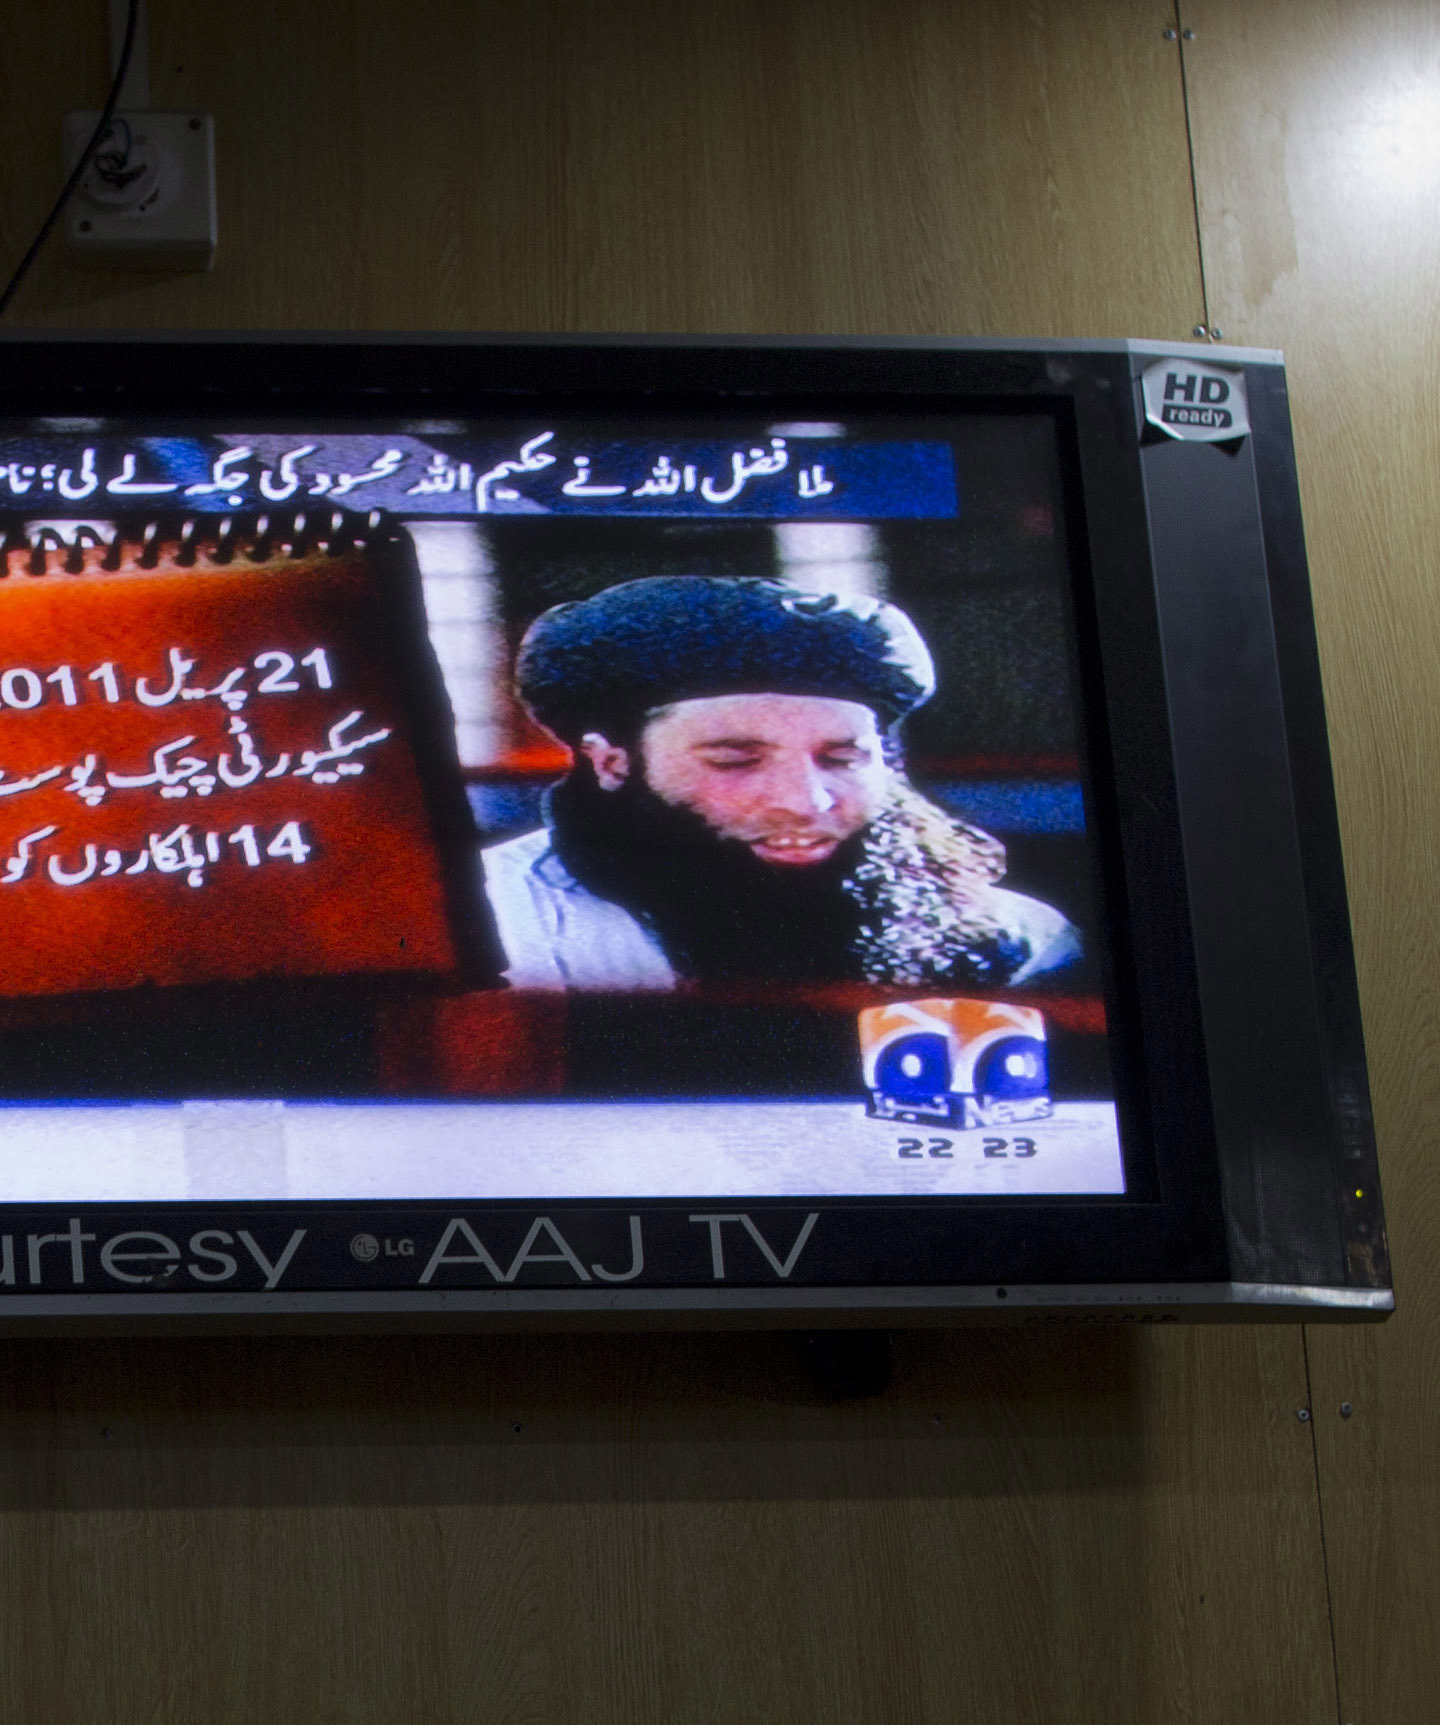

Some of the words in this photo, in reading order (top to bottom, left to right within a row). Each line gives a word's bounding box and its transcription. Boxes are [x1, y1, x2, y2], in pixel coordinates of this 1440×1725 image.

[1163, 372, 1230, 404] HD
[1170, 406, 1224, 428] ready
[107, 453, 177, 494] لے
[184, 446, 251, 505] جگہ
[259, 445, 317, 500] کی
[308, 449, 403, 498] محسود
[477, 432, 557, 511] حکیم
[561, 456, 626, 498] نے
[700, 438, 788, 503] فضل
[798, 465, 834, 498] ملا
[253, 648, 333, 693] 21
[107, 734, 215, 797] چیک
[217, 711, 390, 788] سیکیورٹی
[1, 825, 57, 883] کو
[47, 823, 218, 888] اہلکاروں
[226, 821, 312, 867] 14
[897, 1137, 954, 1159] 22
[982, 1137, 1037, 1159] 23
[384, 1238, 415, 1257] LG
[418, 1214, 644, 1284] AAJ
[689, 1212, 820, 1280] TV
